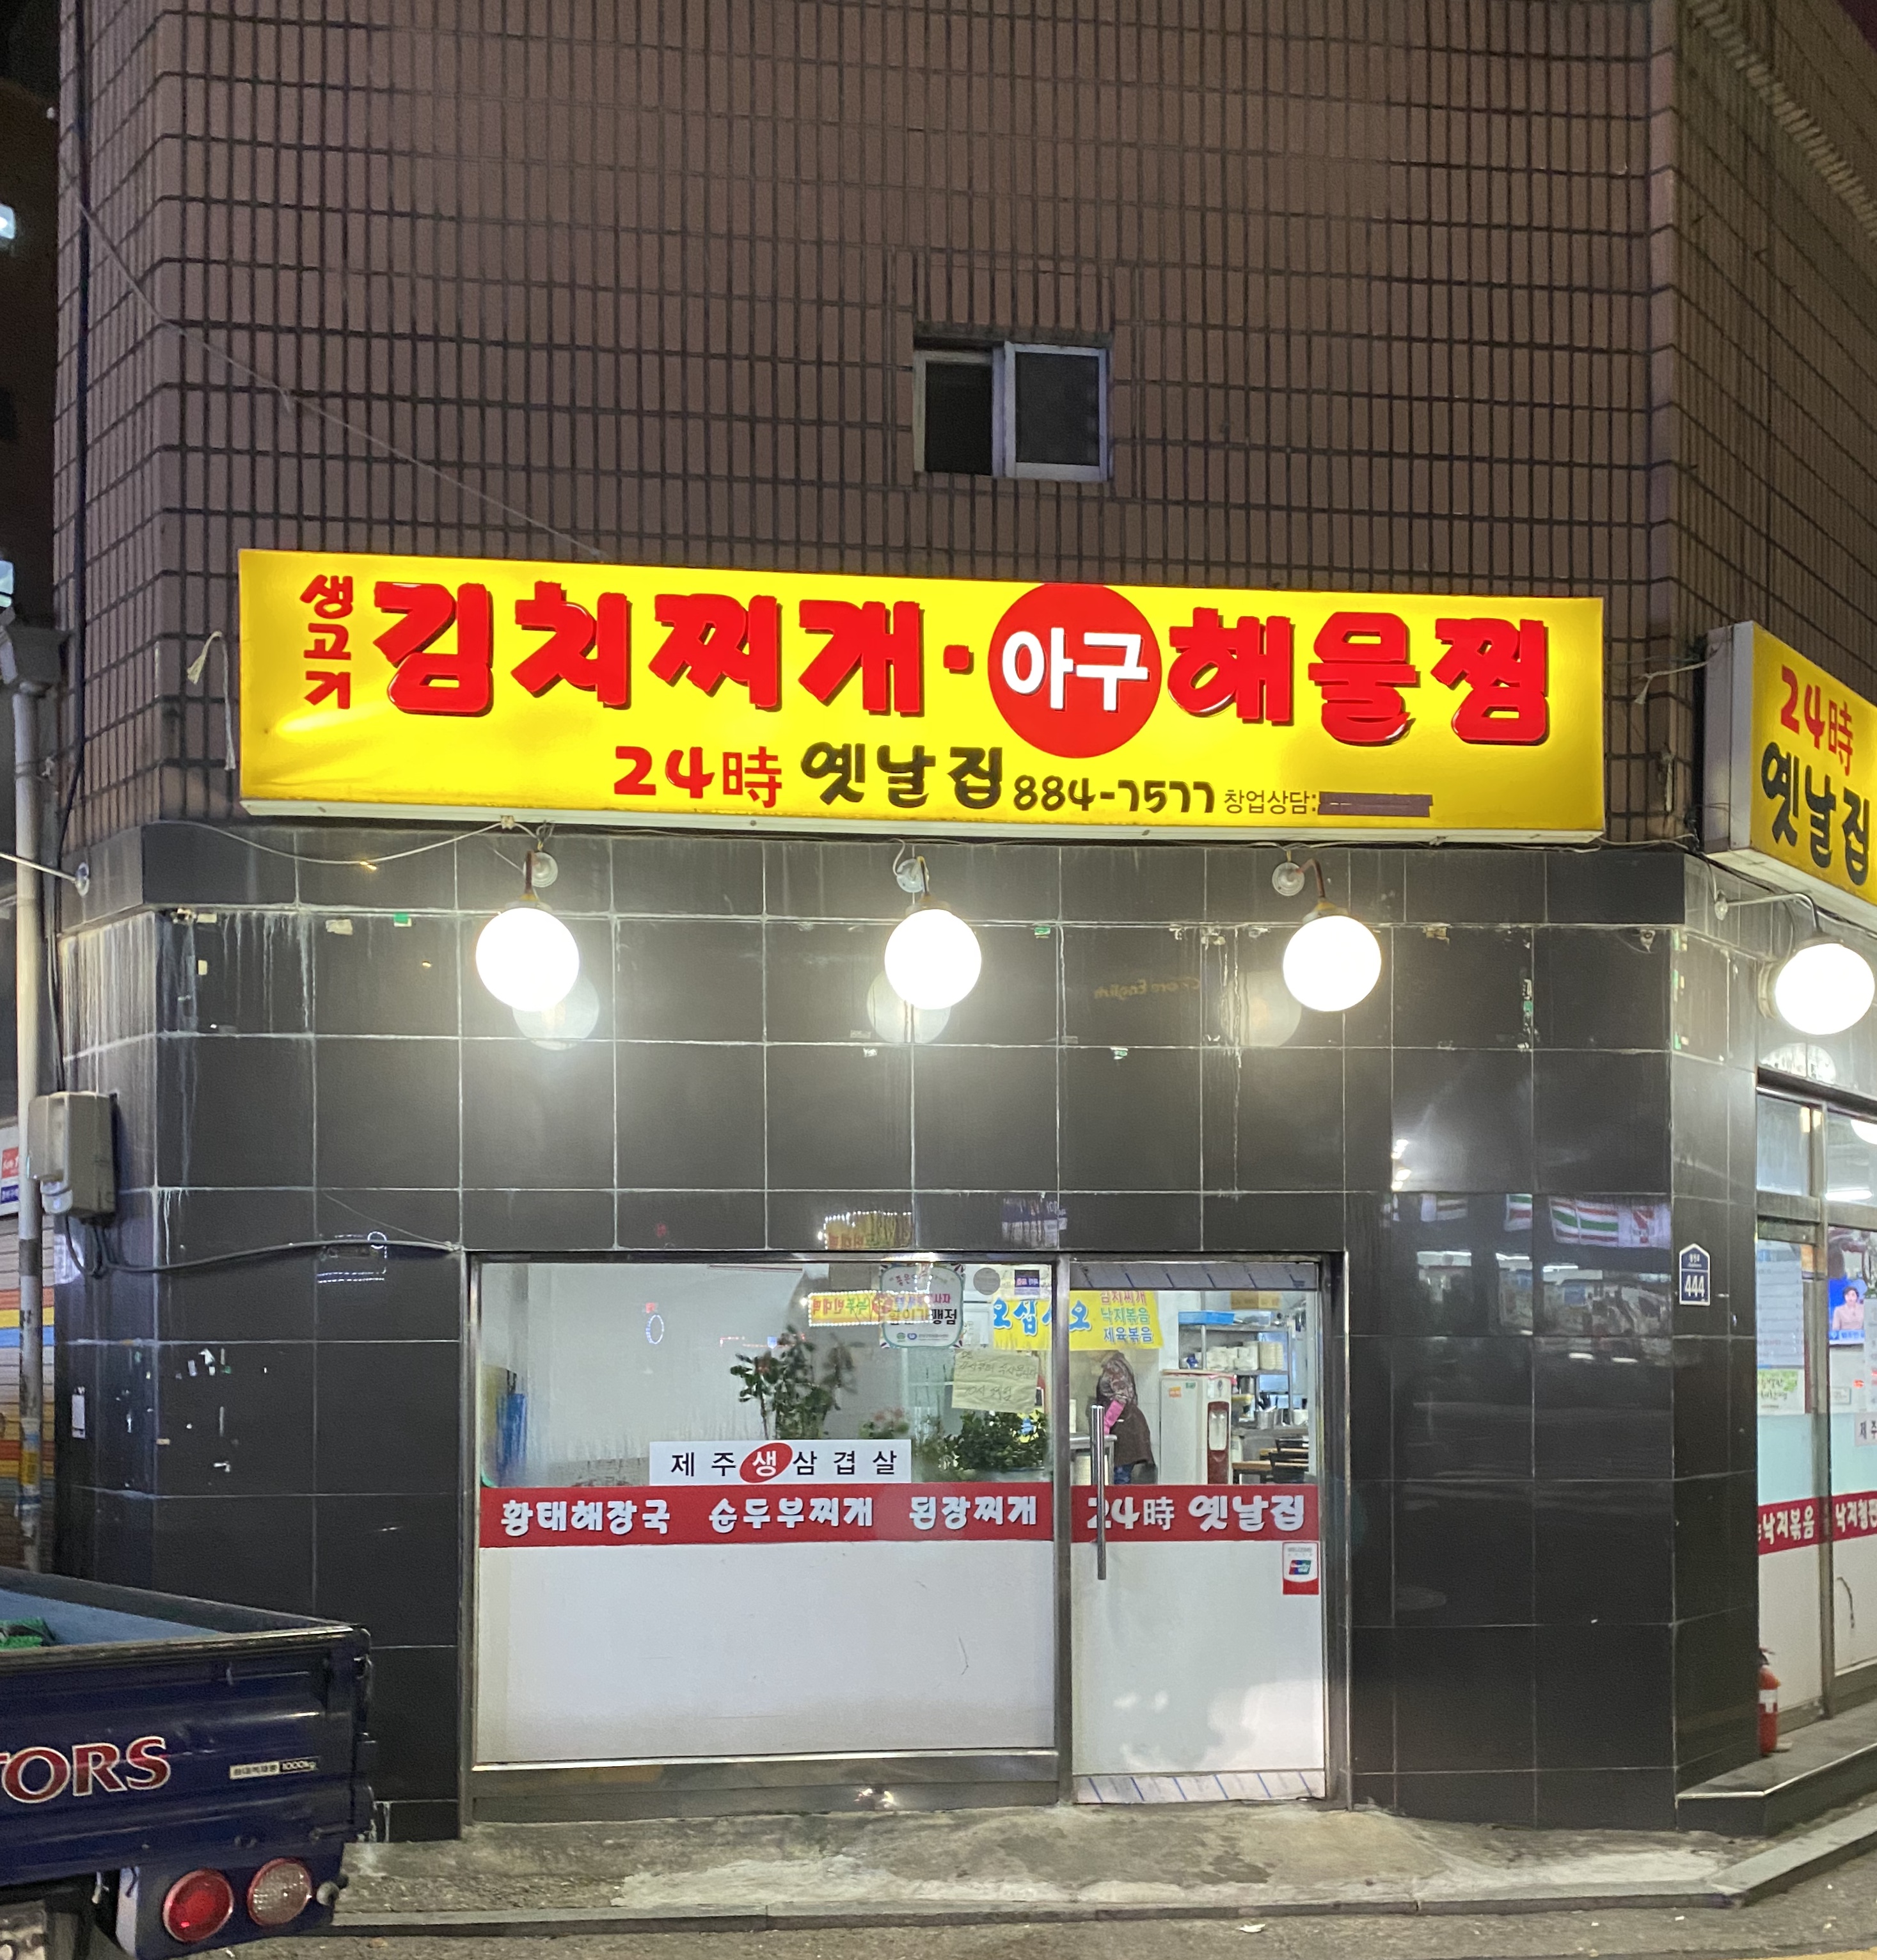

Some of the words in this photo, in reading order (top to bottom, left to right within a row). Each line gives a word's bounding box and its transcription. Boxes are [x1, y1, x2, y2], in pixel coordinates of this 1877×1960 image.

[299, 574, 353, 710] 생고기
[373, 581, 925, 717] 김치찌개
[1002, 626, 1149, 712] 아구
[1168, 607, 1550, 747] 해물찜
[1780, 665, 1853, 776] 24時
[614, 745, 782, 809] 24時
[800, 741, 1004, 809] 옛날집
[1013, 774, 1216, 814] 884-7577
[1761, 741, 1871, 886] 옛날집
[1684, 1274, 1705, 1298] 444
[1100, 1307, 1150, 1325] 낙지볶음
[1103, 1327, 1153, 1344] 제육볶음
[670, 1451, 736, 1477] 제주
[752, 1451, 778, 1478] 생
[793, 1449, 897, 1476] 삼겹살
[501, 1499, 670, 1536] 황태해장국
[709, 1496, 874, 1533] 순두부찌개
[909, 1495, 1037, 1530] 된장찌개
[1188, 1494, 1305, 1532] 옛날집
[1757, 1504, 1815, 1545] 낙지볶음
[0, 1736, 171, 1804] ORS
